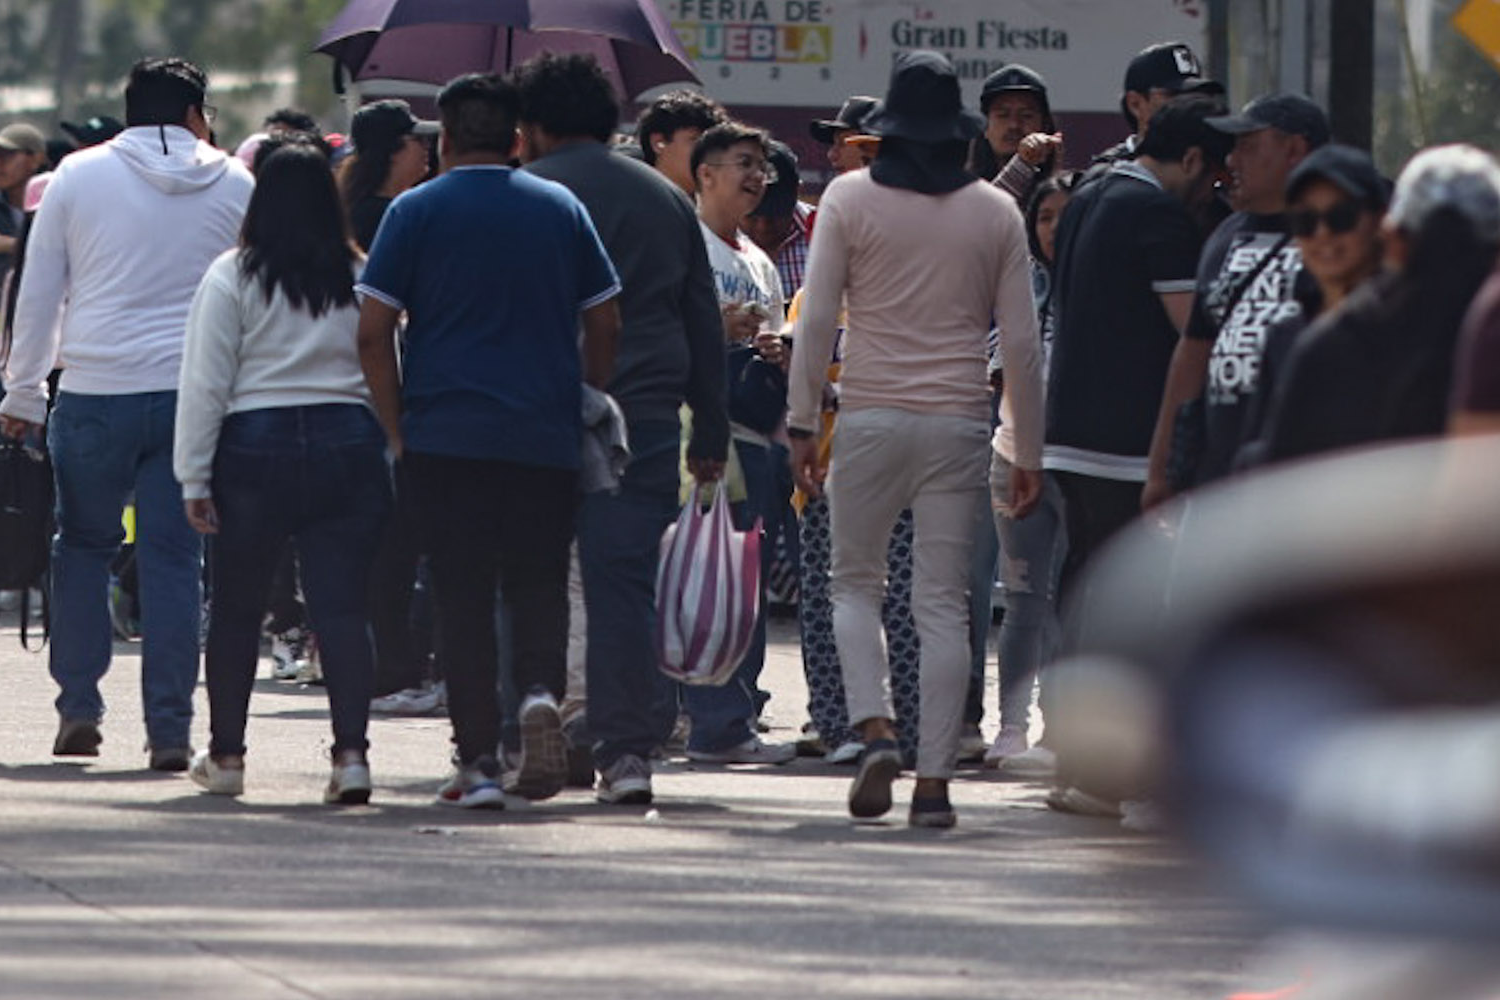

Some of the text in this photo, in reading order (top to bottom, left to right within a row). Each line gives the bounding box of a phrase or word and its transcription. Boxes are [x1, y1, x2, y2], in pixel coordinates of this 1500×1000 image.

[785, 0, 822, 22] DE
[891, 18, 1070, 50] Gran Fiesta
